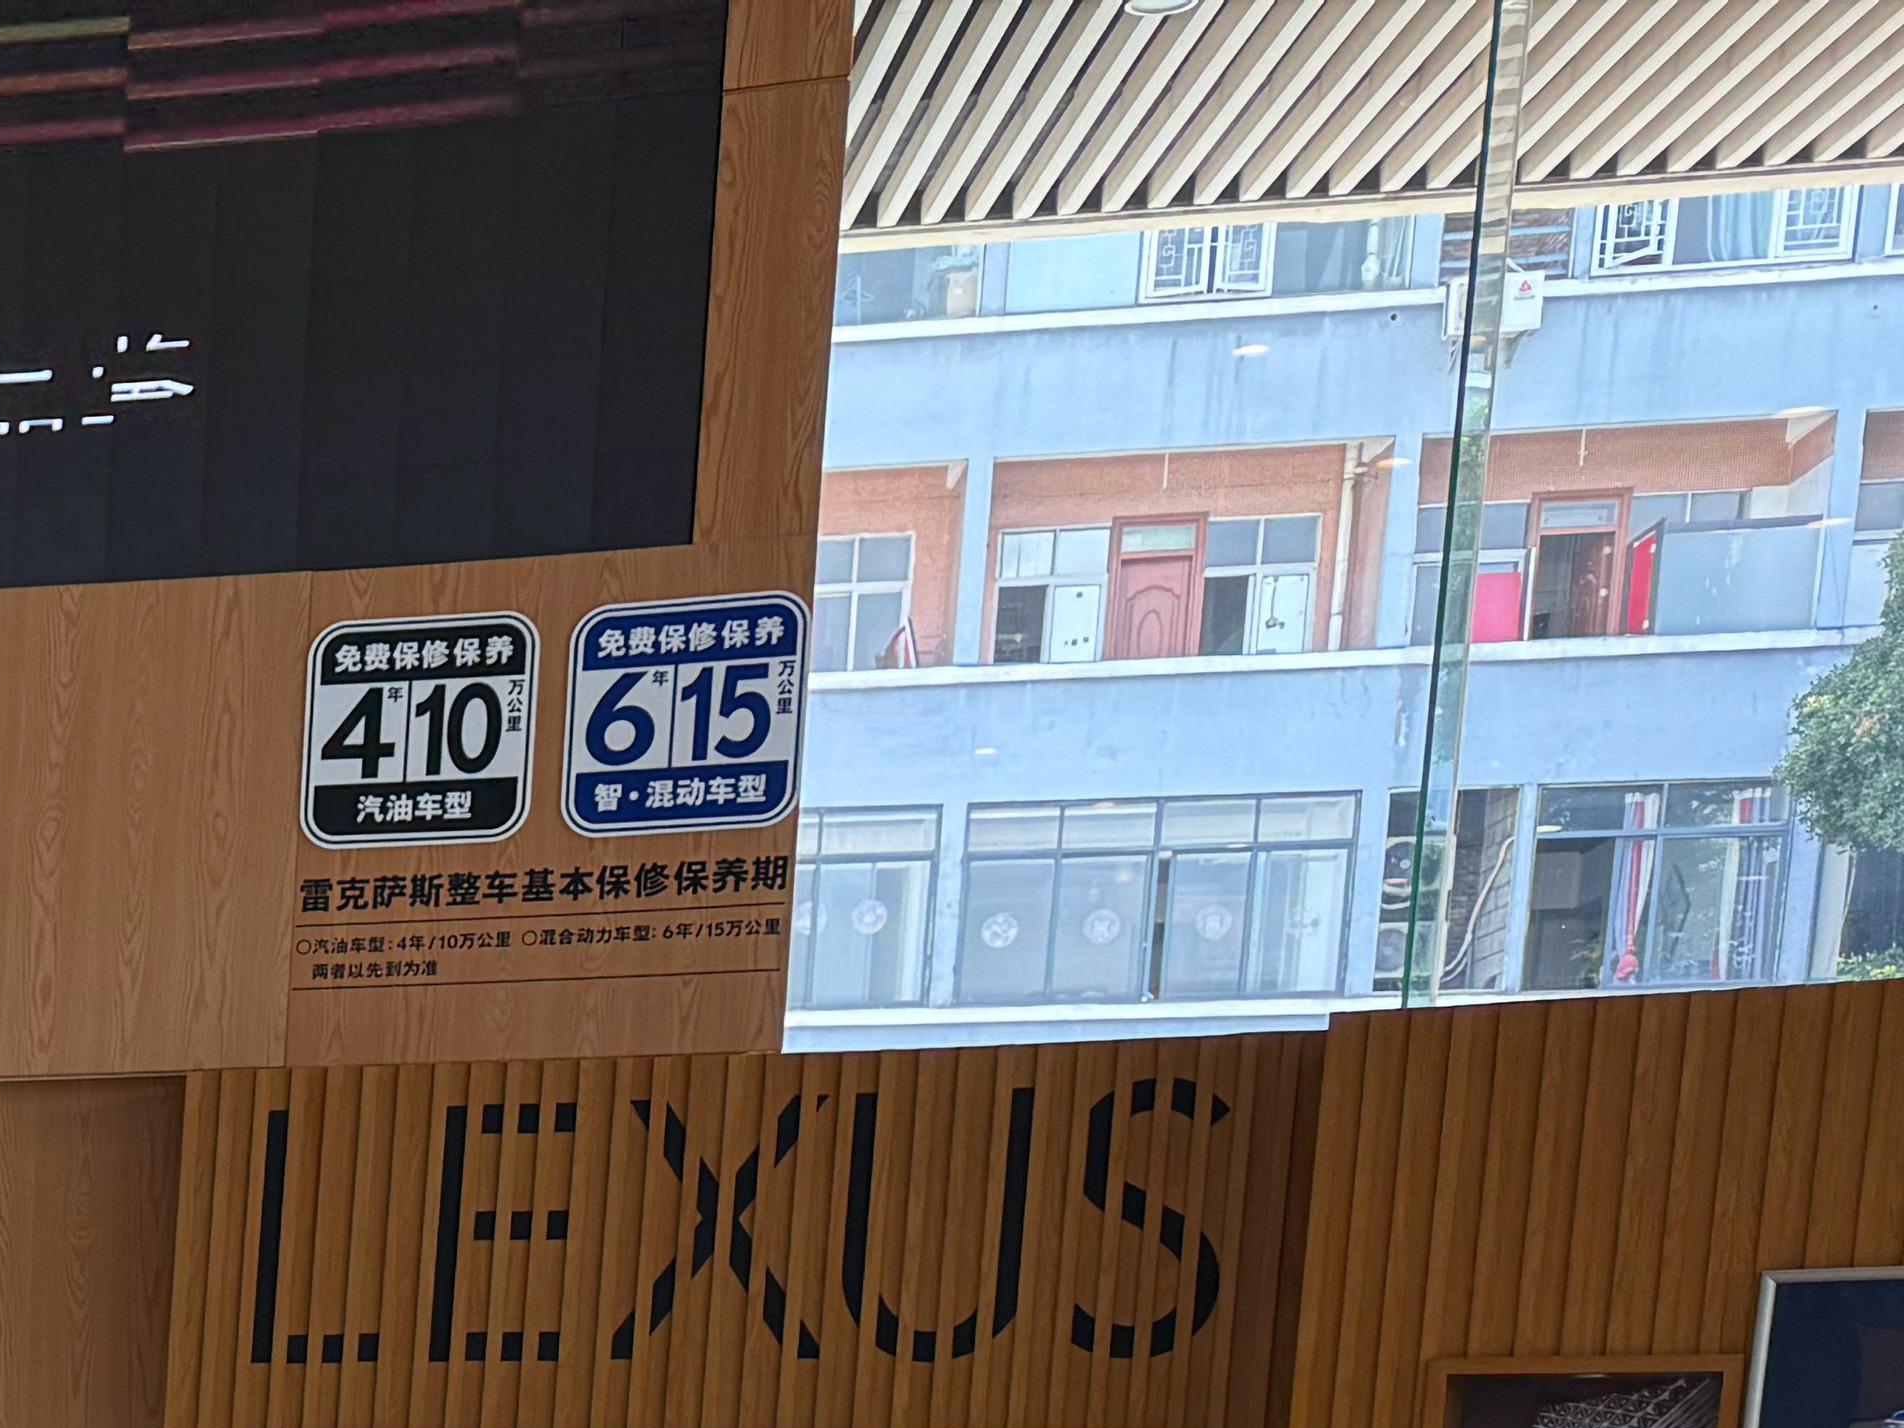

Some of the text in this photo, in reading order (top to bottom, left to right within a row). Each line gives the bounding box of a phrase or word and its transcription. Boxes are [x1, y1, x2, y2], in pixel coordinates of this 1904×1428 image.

[334, 635, 514, 673] 免费保修保养
[597, 616, 785, 659] 免费保修保养
[321, 679, 525, 779] 4 年 10 万公里
[585, 660, 796, 766] 6 年 15 万公里
[356, 791, 472, 823] 汽油车型
[300, 856, 789, 913] 雷克萨斯整车基本保修保养期
[312, 960, 438, 980] 两者以先到为准
[251, 1078, 1231, 1364] LEXUS
